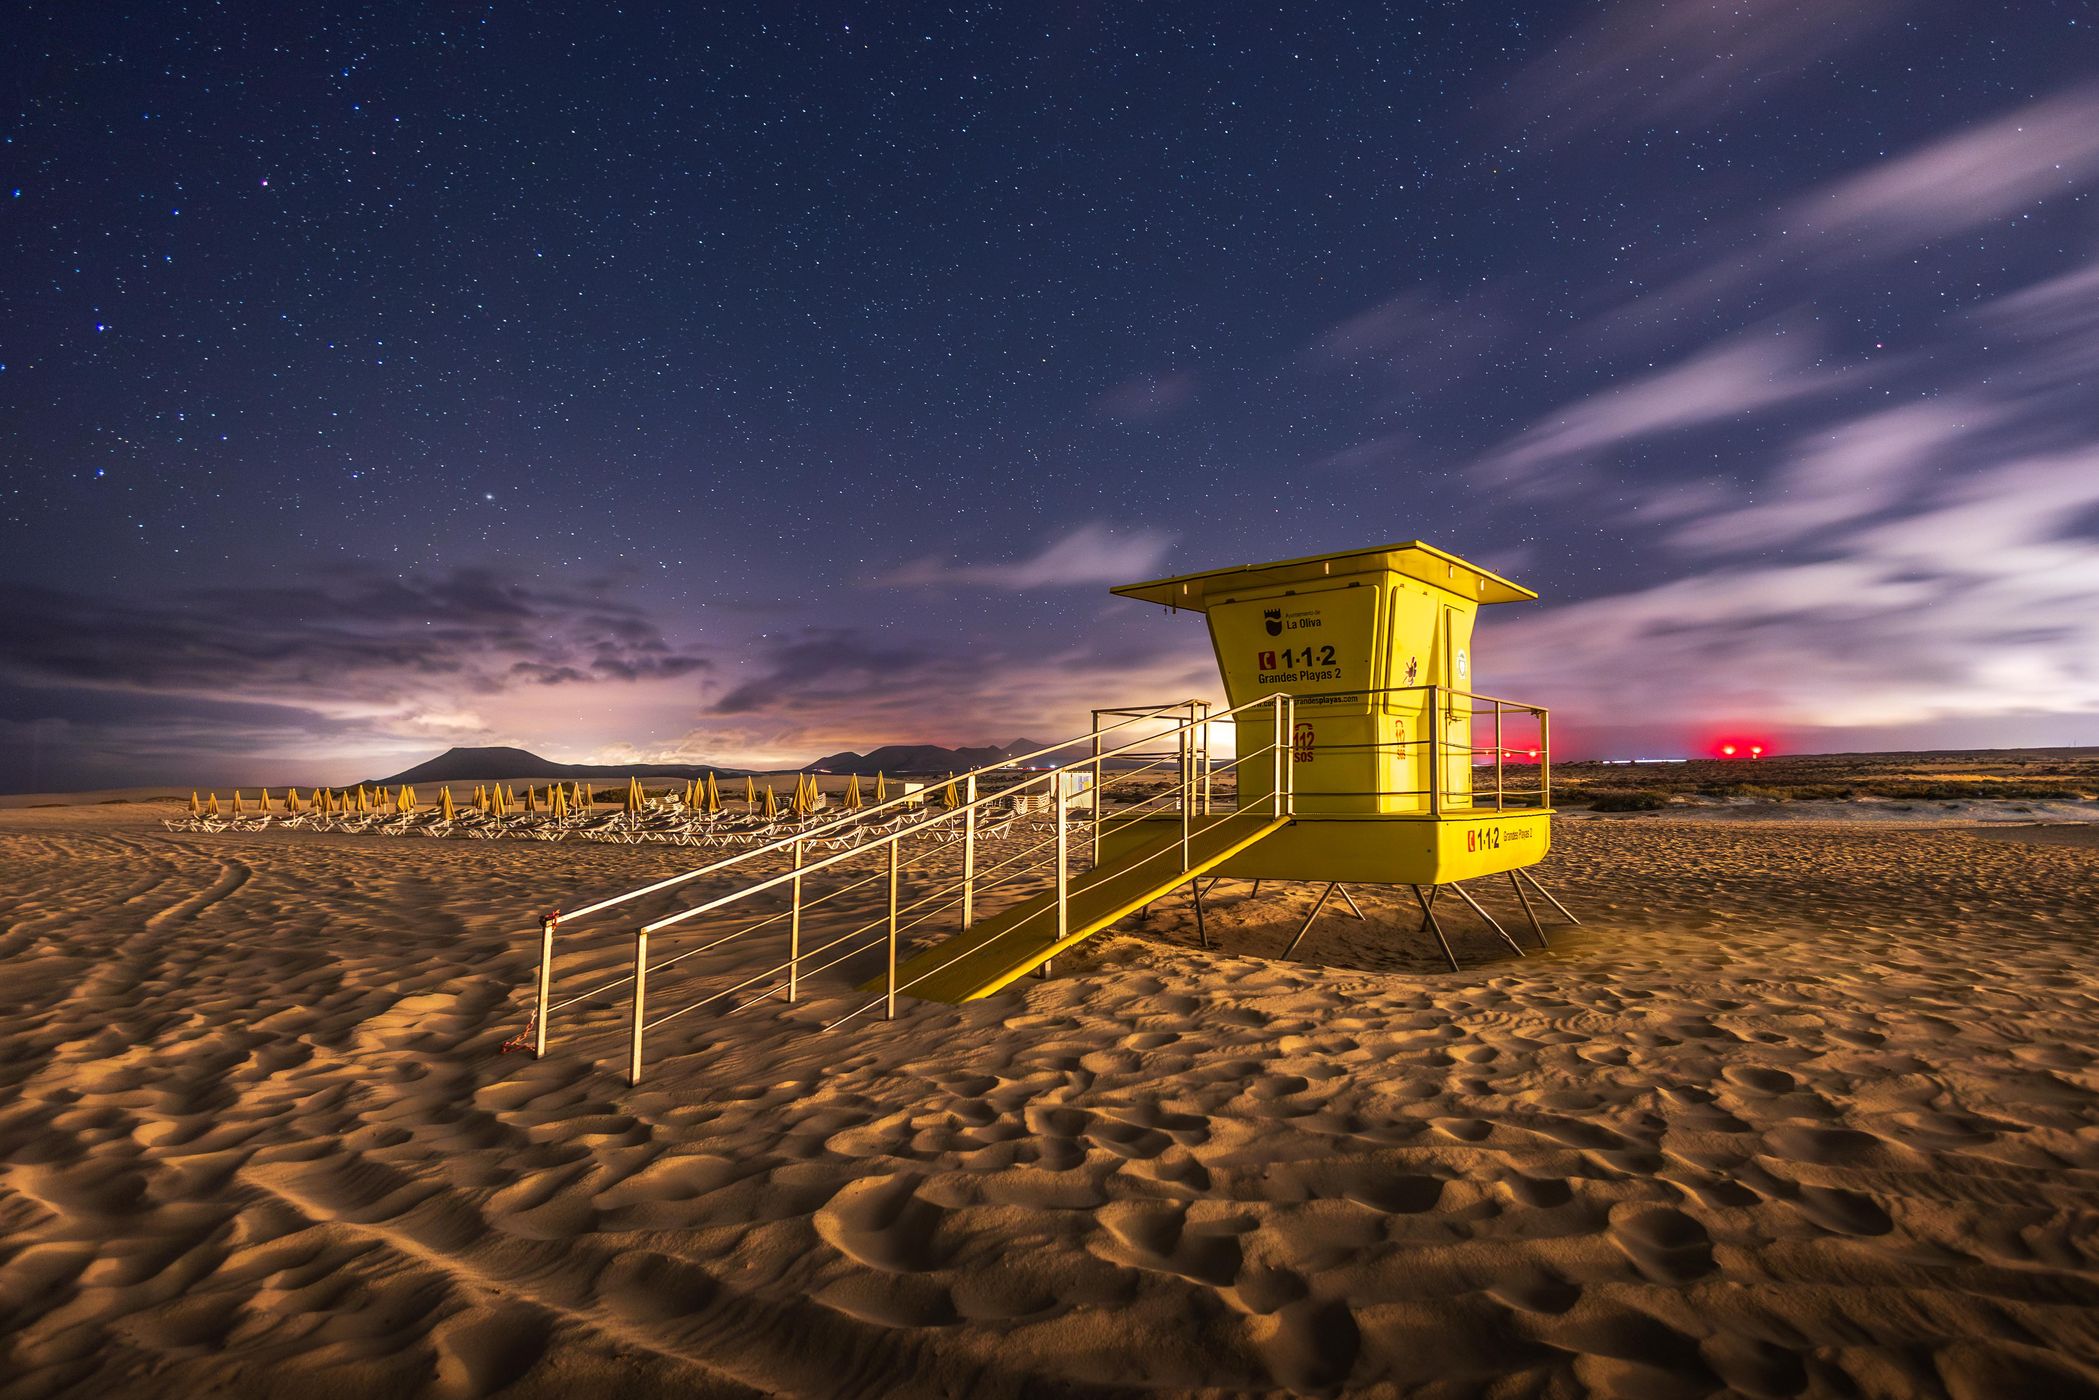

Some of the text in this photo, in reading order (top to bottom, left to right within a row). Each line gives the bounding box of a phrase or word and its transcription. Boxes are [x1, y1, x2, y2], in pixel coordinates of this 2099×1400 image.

[1286, 618, 1322, 630] La Oliva
[1258, 667, 1342, 684] Grandes Playas 2
[1293, 731, 1315, 750] 112
[1294, 752, 1314, 763] SOS
